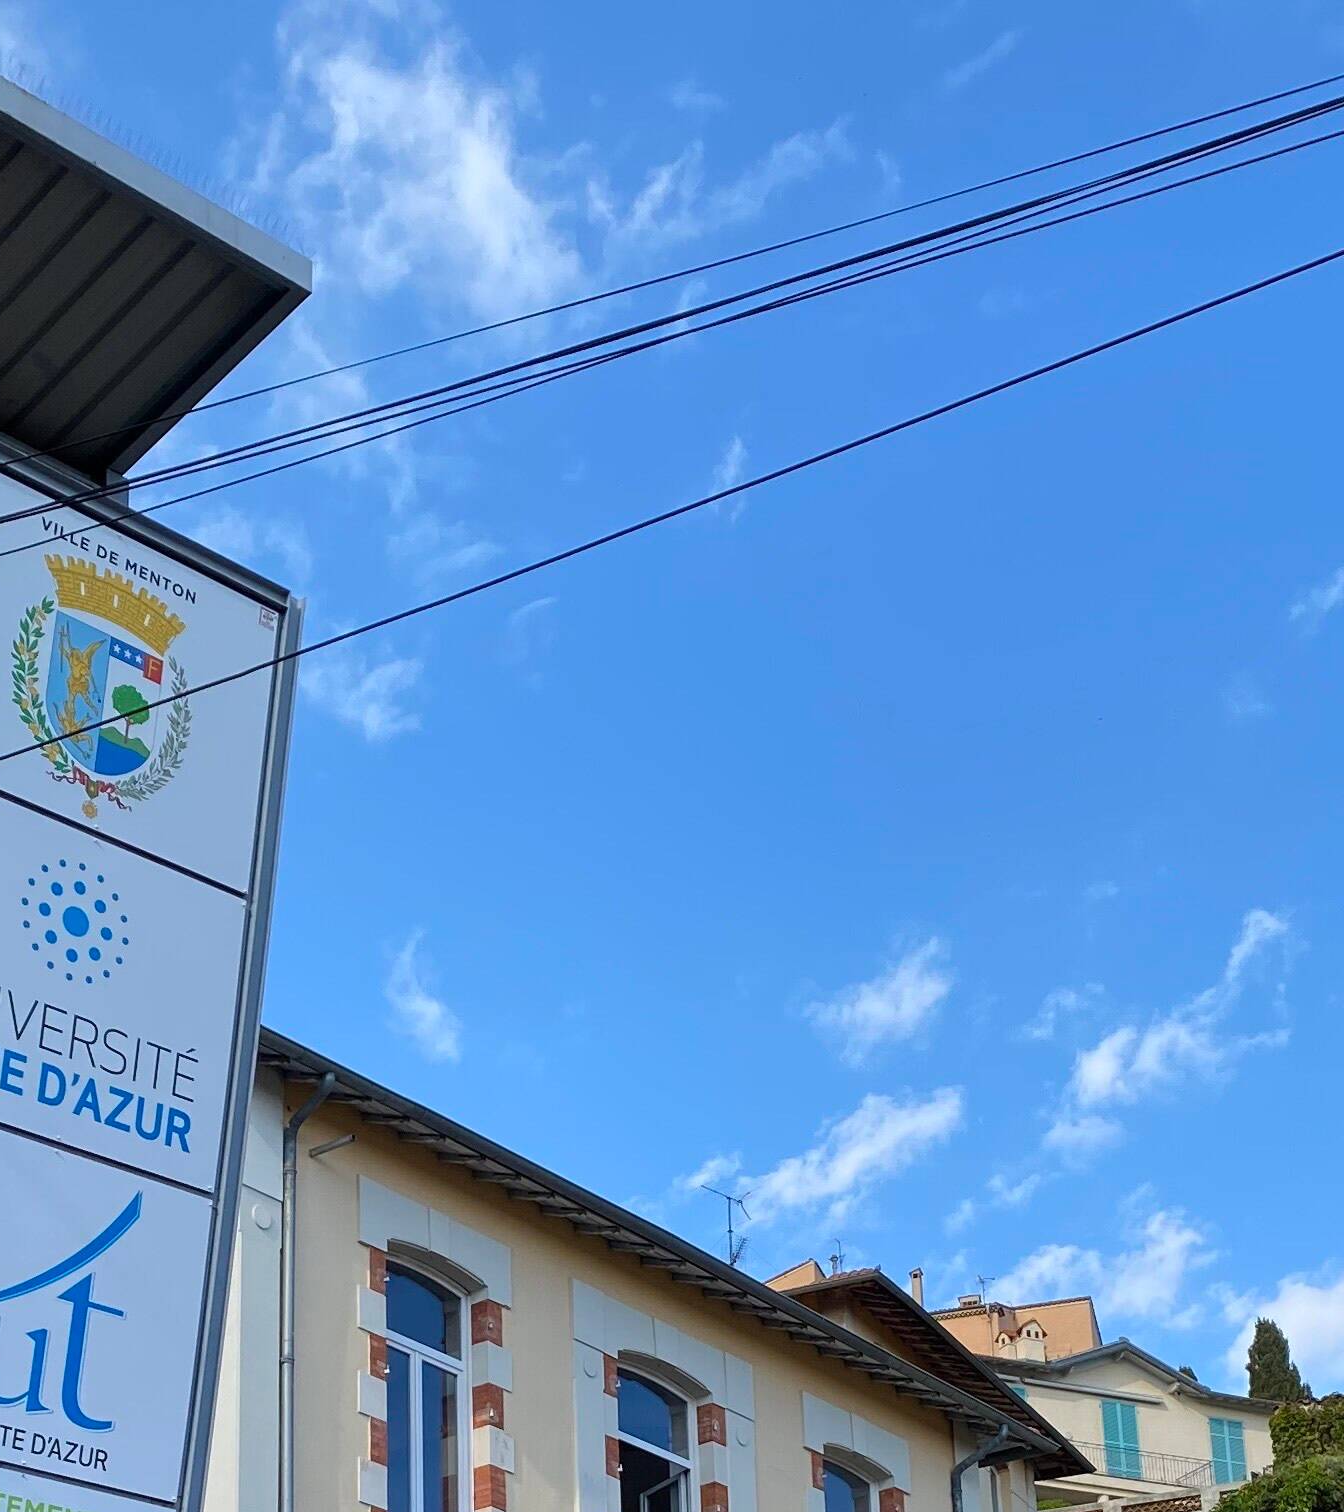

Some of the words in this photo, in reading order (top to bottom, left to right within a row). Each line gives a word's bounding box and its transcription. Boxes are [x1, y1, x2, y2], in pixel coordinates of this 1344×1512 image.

[41, 516, 91, 552] VILLE
[96, 544, 120, 566] DE
[125, 558, 197, 604] MENTON
[36, 1061, 192, 1154] D'AZUR
[30, 1432, 109, 1472] D'AZUR
